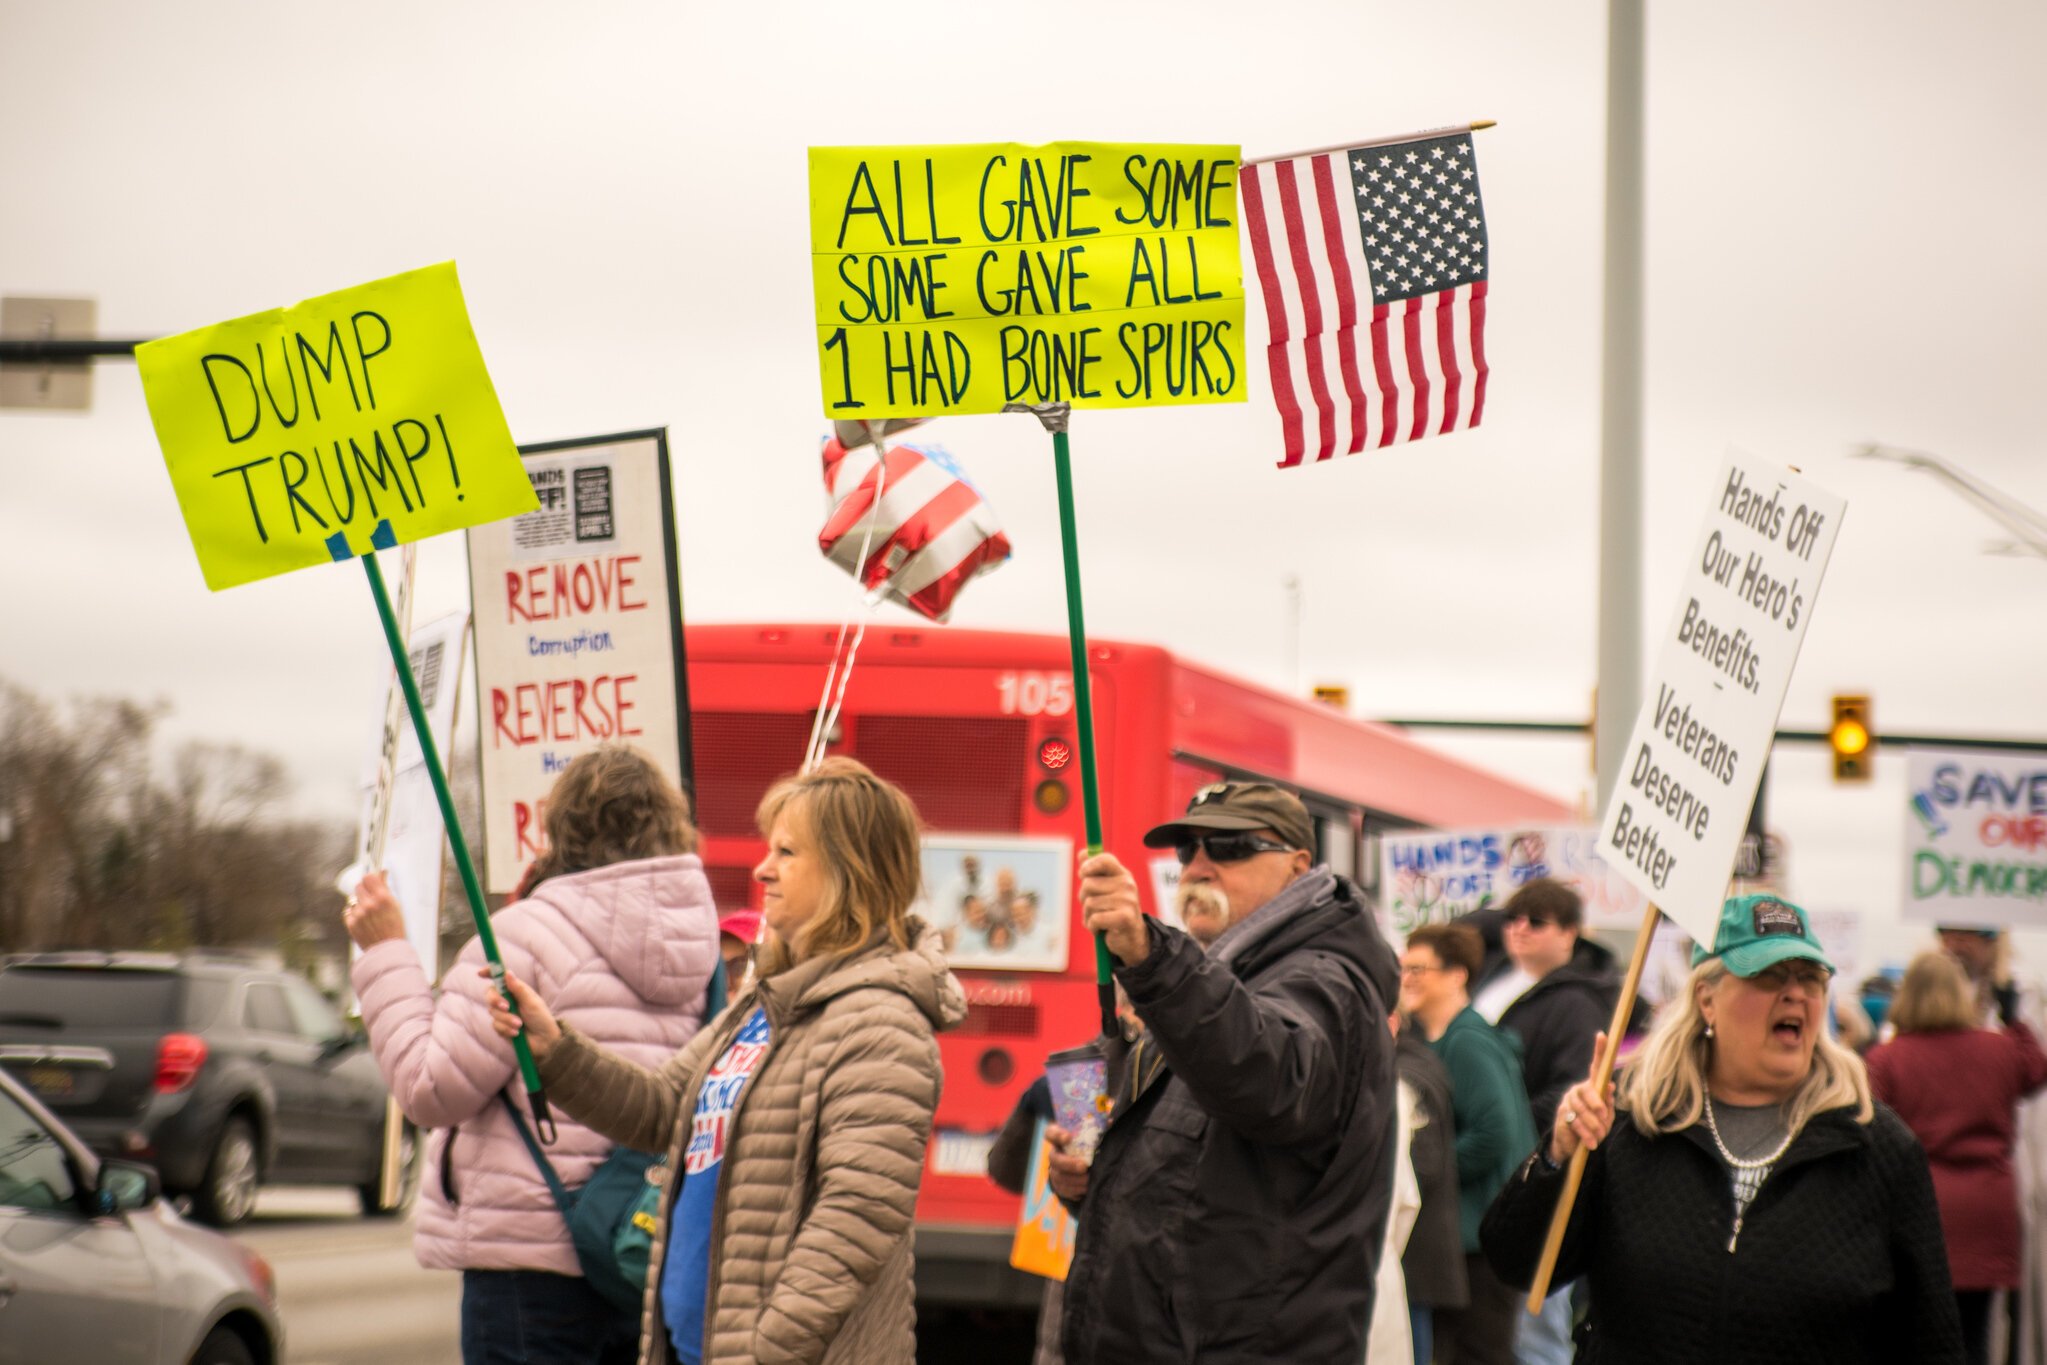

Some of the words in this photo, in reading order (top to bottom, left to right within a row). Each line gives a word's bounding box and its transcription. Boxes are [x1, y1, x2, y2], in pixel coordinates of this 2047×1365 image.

[837, 158, 961, 248] ALL
[978, 154, 1101, 242] GAVE
[1115, 154, 1236, 230] SOME
[838, 253, 955, 324] SOME
[976, 245, 1092, 316] GAVE
[1125, 236, 1223, 308] ALL
[201, 310, 392, 444] DUMP
[824, 327, 866, 409] 1
[883, 330, 971, 407] HAD
[1000, 325, 1102, 401] BONE
[1115, 320, 1237, 400] SPURS
[213, 413, 466, 545] TRUMP!
[1720, 466, 1786, 541] Hands
[1786, 503, 1825, 562] Off
[505, 554, 647, 626] REMOVE
[1702, 530, 1741, 589] Our
[1737, 550, 1803, 632] Hero's
[529, 629, 615, 658] Corruption
[1678, 597, 1761, 695] Benefits.
[491, 674, 643, 748] REVERSE
[992, 670, 1074, 716] 105
[1653, 682, 1739, 786] Veterans
[1630, 742, 1711, 842] Deserve
[1932, 762, 2047, 815] SAVE
[1393, 835, 1501, 872] HANDS
[1611, 802, 1677, 891] Better
